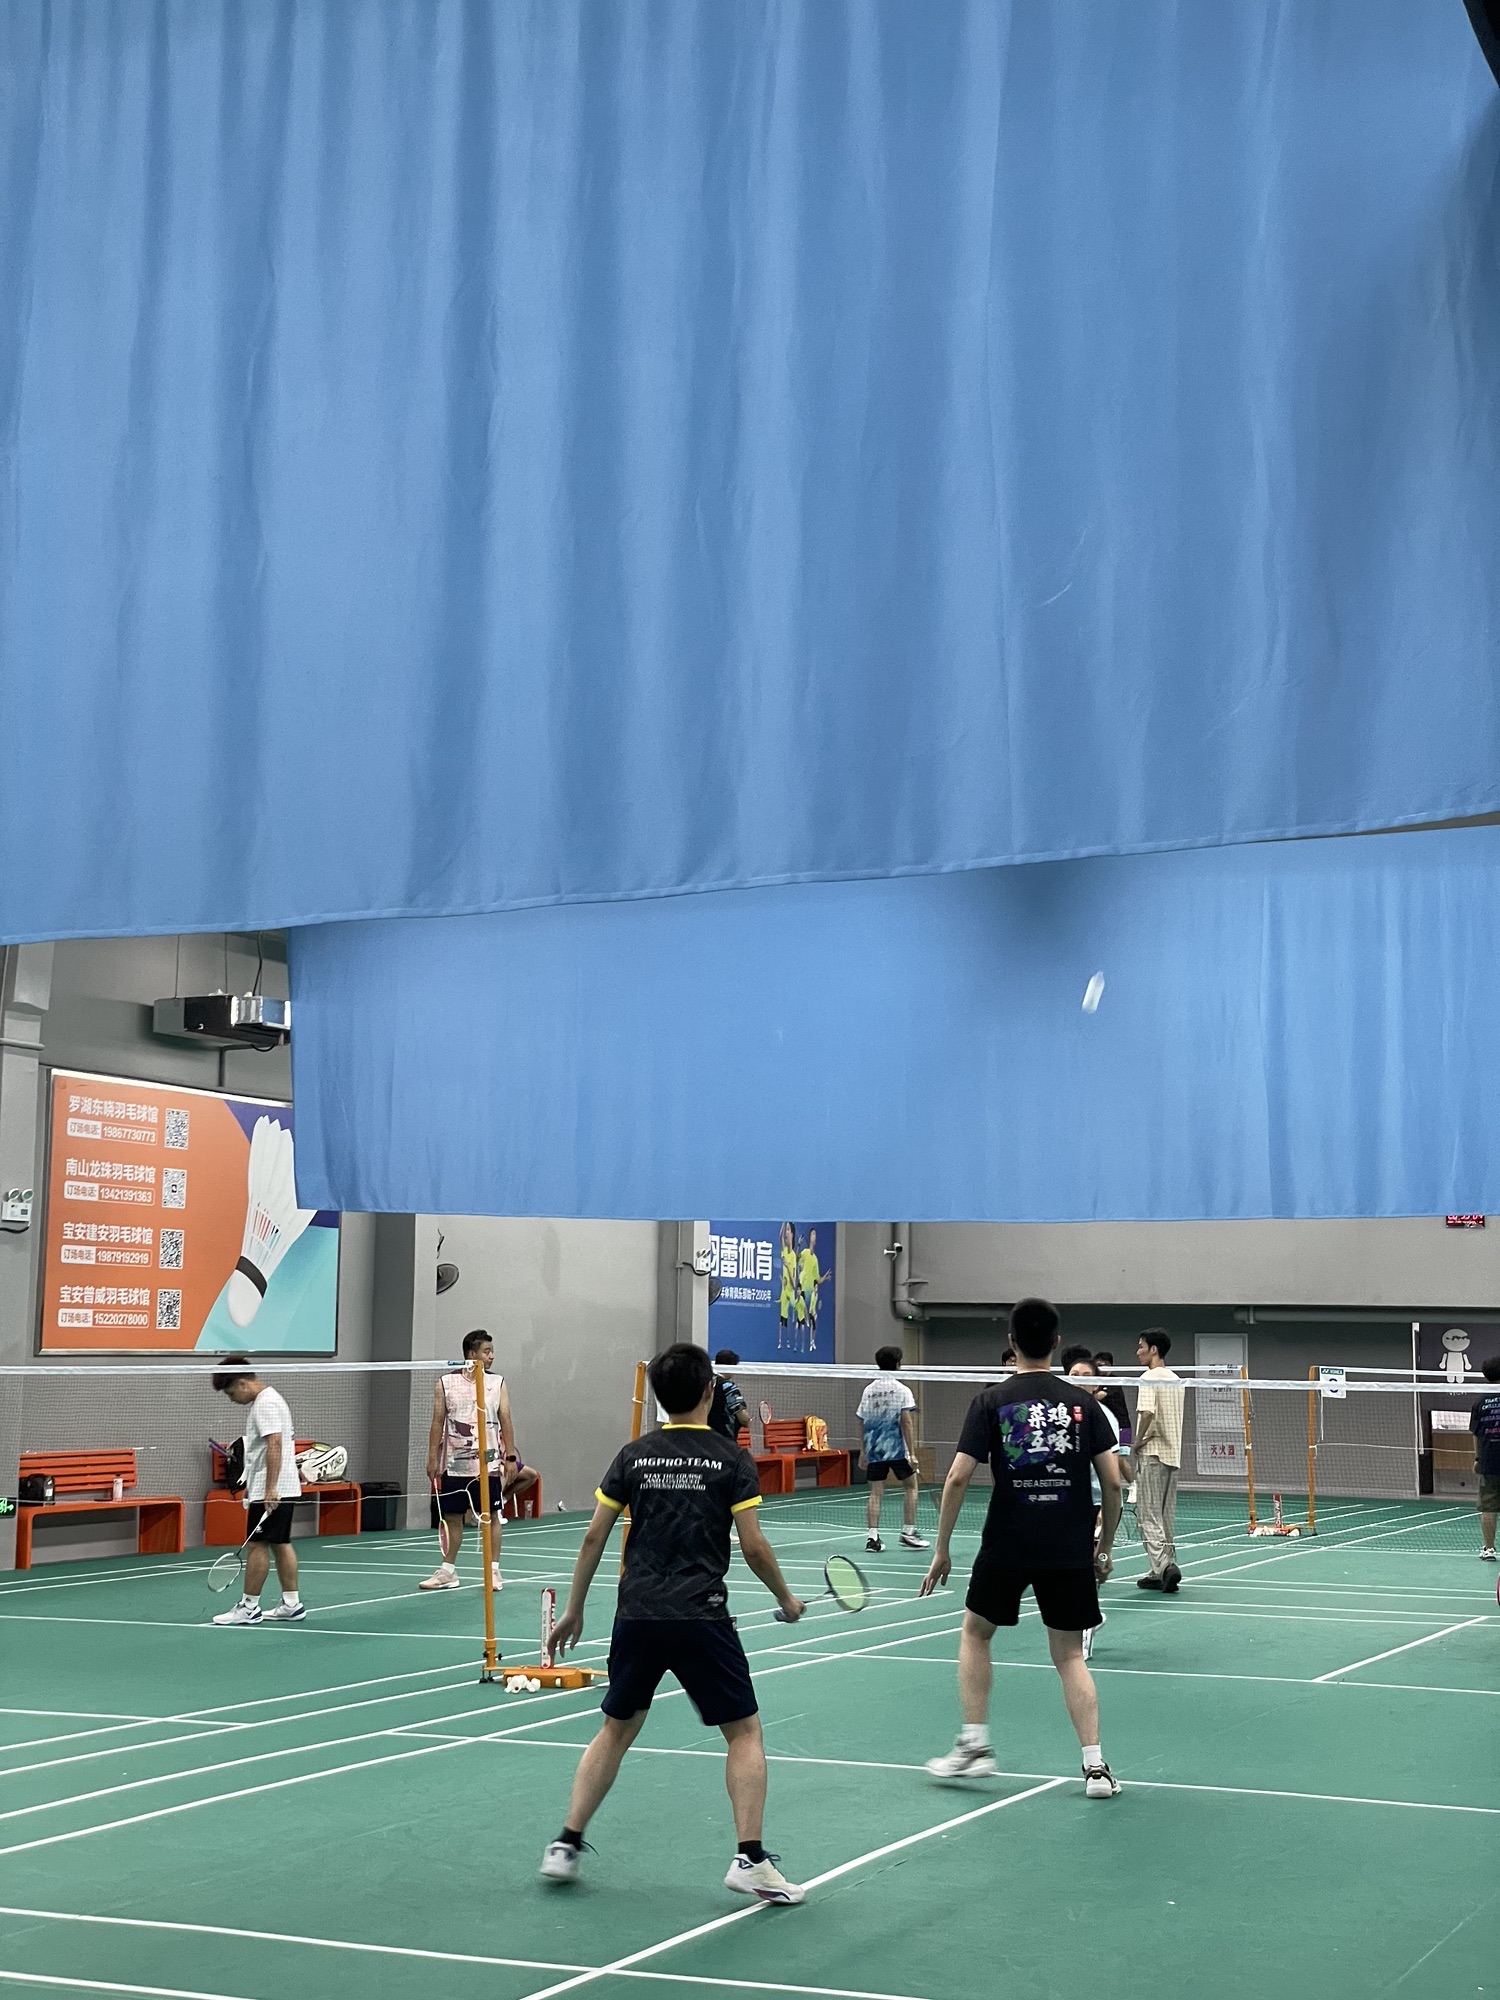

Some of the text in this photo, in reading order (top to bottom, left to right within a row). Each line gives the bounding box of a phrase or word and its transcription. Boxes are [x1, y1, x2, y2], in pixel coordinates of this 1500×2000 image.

[68, 1094, 159, 1124] 罗湖东晓羽毛球馆
[102, 1126, 156, 1144] 19867730773
[65, 1157, 156, 1184] 南山龙珠羽毛球馆
[99, 1187, 153, 1203] 13421391363
[62, 1221, 154, 1245] 宝安建安羽毛球馆
[96, 1250, 149, 1265] 19879192919
[59, 1284, 152, 1306] 宝安普威羽毛球馆
[93, 1313, 148, 1326] 15220278000
[1028, 1402, 1072, 1429] 菜鸡
[1027, 1429, 1073, 1453] 互啄
[1210, 1444, 1235, 1456] 灭火器
[632, 1457, 722, 1470] JMGPRO-TEAM
